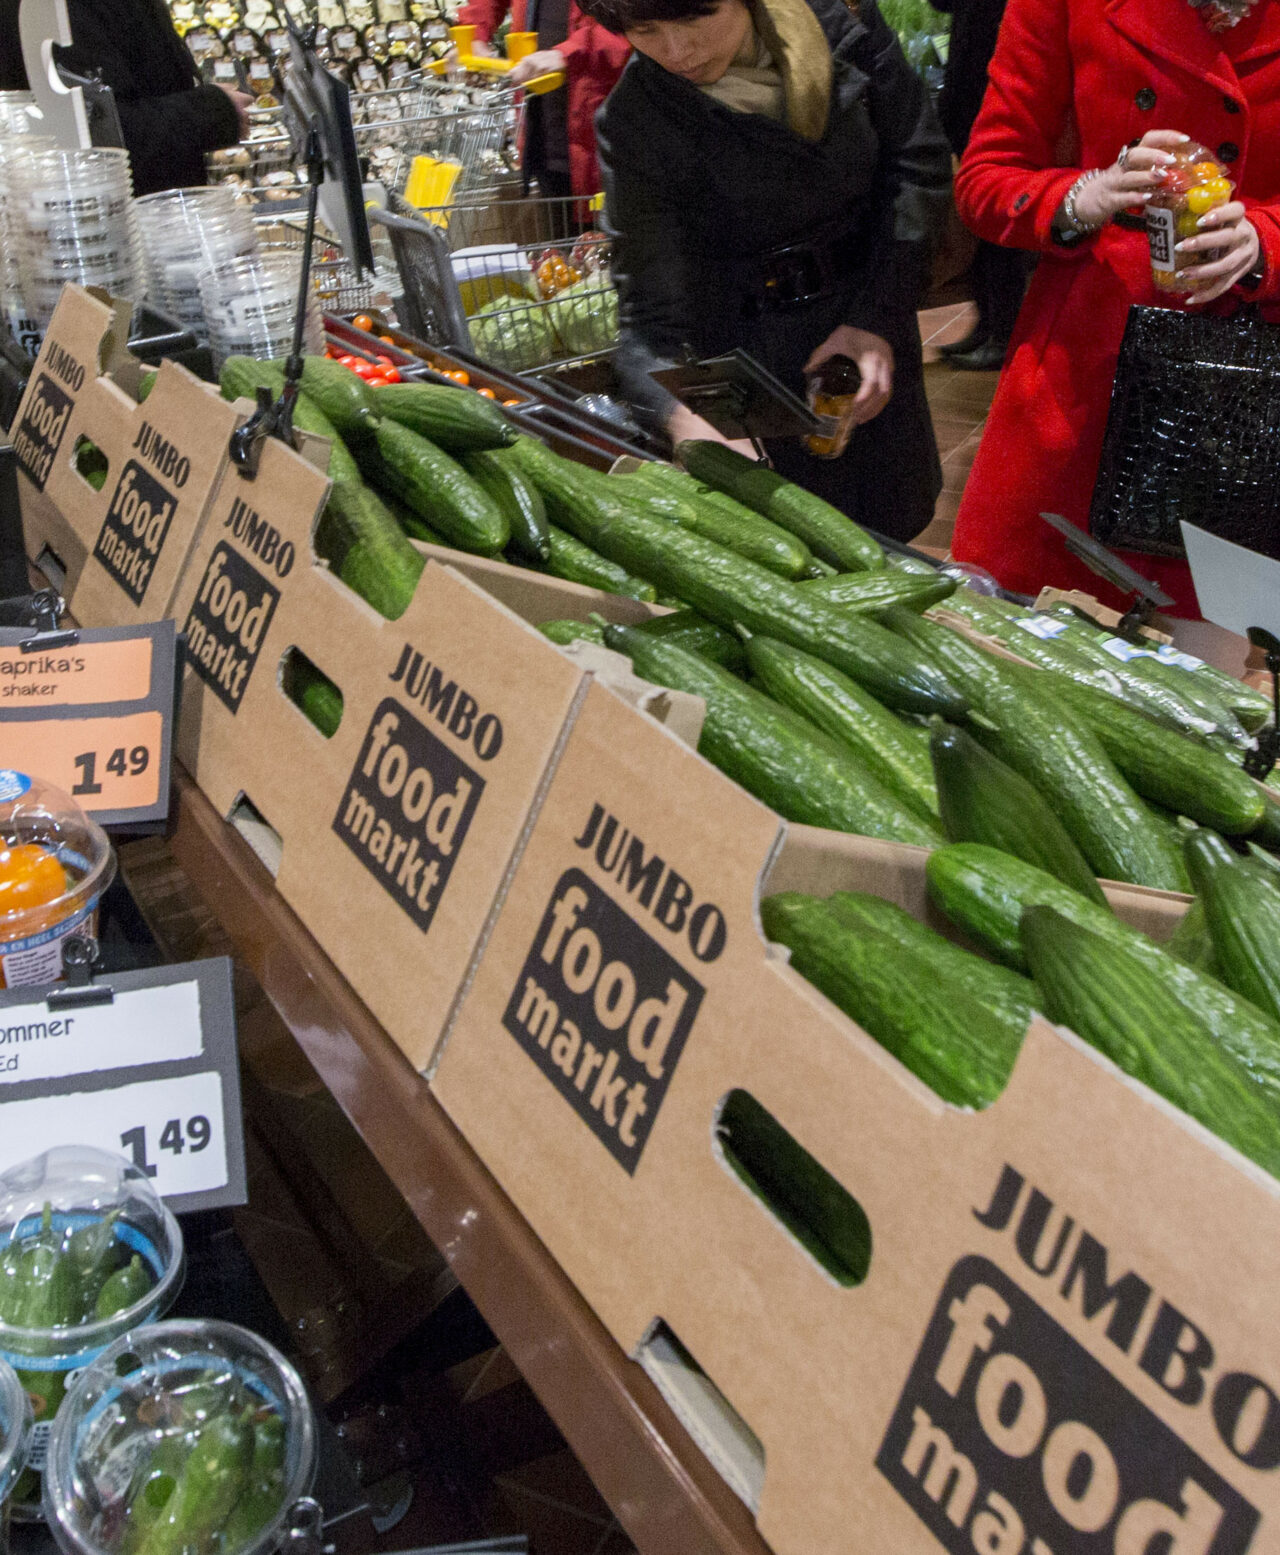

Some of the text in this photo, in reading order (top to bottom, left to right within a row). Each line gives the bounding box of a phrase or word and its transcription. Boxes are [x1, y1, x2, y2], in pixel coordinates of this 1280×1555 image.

[44, 341, 85, 392] JUMBO
[14, 428, 52, 483] markt
[25, 380, 70, 449] food
[132, 421, 190, 488] JUMBO
[112, 469, 172, 554] food
[224, 497, 295, 578] JUMBO
[99, 525, 150, 593] markt
[200, 551, 273, 654] food
[2, 682, 58, 697] shaker
[186, 614, 248, 699] markt
[388, 642, 503, 762] JUMBO
[361, 712, 472, 857] food
[343, 788, 440, 912] markt
[574, 802, 727, 963] JUMBO
[541, 885, 689, 1080] food
[516, 976, 648, 1149] markt
